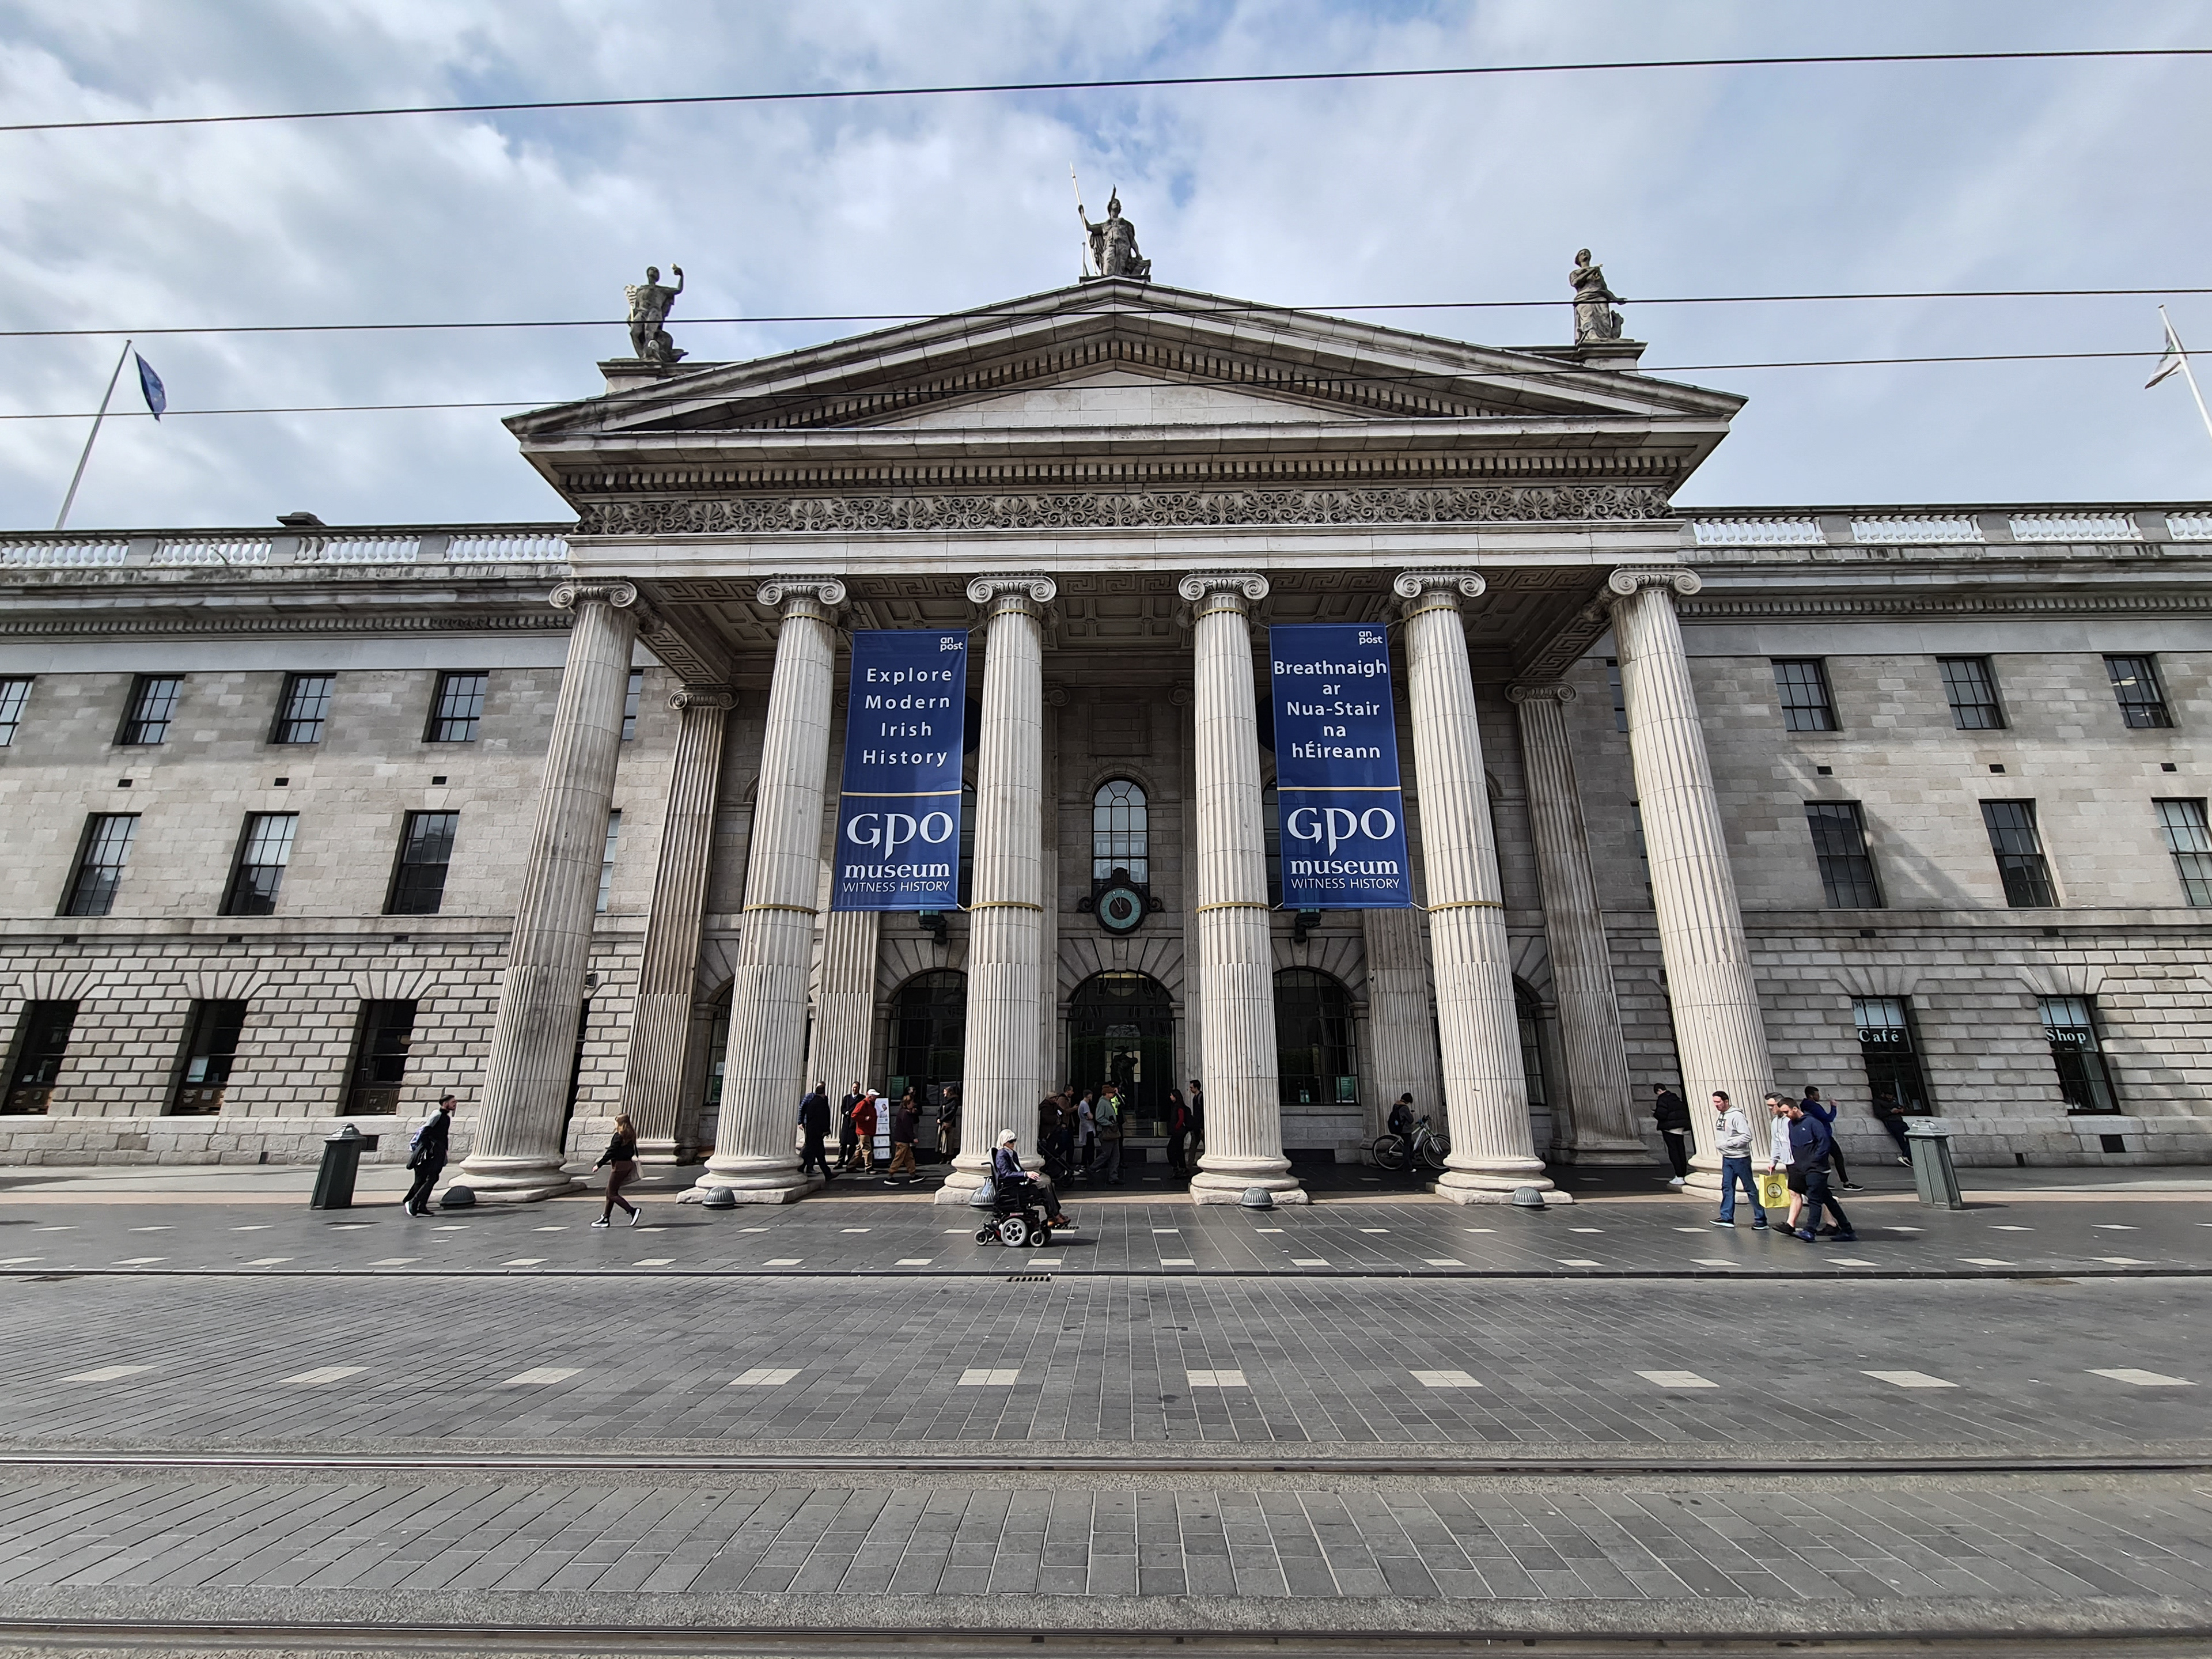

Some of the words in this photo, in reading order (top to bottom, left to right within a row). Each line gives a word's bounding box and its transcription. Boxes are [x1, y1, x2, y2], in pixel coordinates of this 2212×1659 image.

[940, 642, 964, 652] post
[1358, 635, 1383, 645] post
[866, 667, 952, 685] Explore
[1274, 659, 1387, 677] Breathnaigh
[1323, 684, 1341, 695] ar
[865, 694, 950, 710] Modern
[1287, 701, 1380, 716] Nua-Stair
[881, 722, 931, 737] Irish
[1323, 725, 1347, 737] na
[1291, 740, 1381, 759] hÉireann
[862, 749, 948, 767] History
[846, 811, 954, 861] GPO
[1287, 807, 1396, 857] GPO
[844, 863, 950, 881] museum
[1290, 860, 1400, 877] museum
[843, 881, 896, 893] WITNESS
[900, 881, 950, 892] HISTORY
[1290, 878, 1346, 889] WITNESS
[1350, 878, 1400, 889] HISTORY
[1858, 1029, 1900, 1043] Café
[2046, 1028, 2087, 1044] Shop
